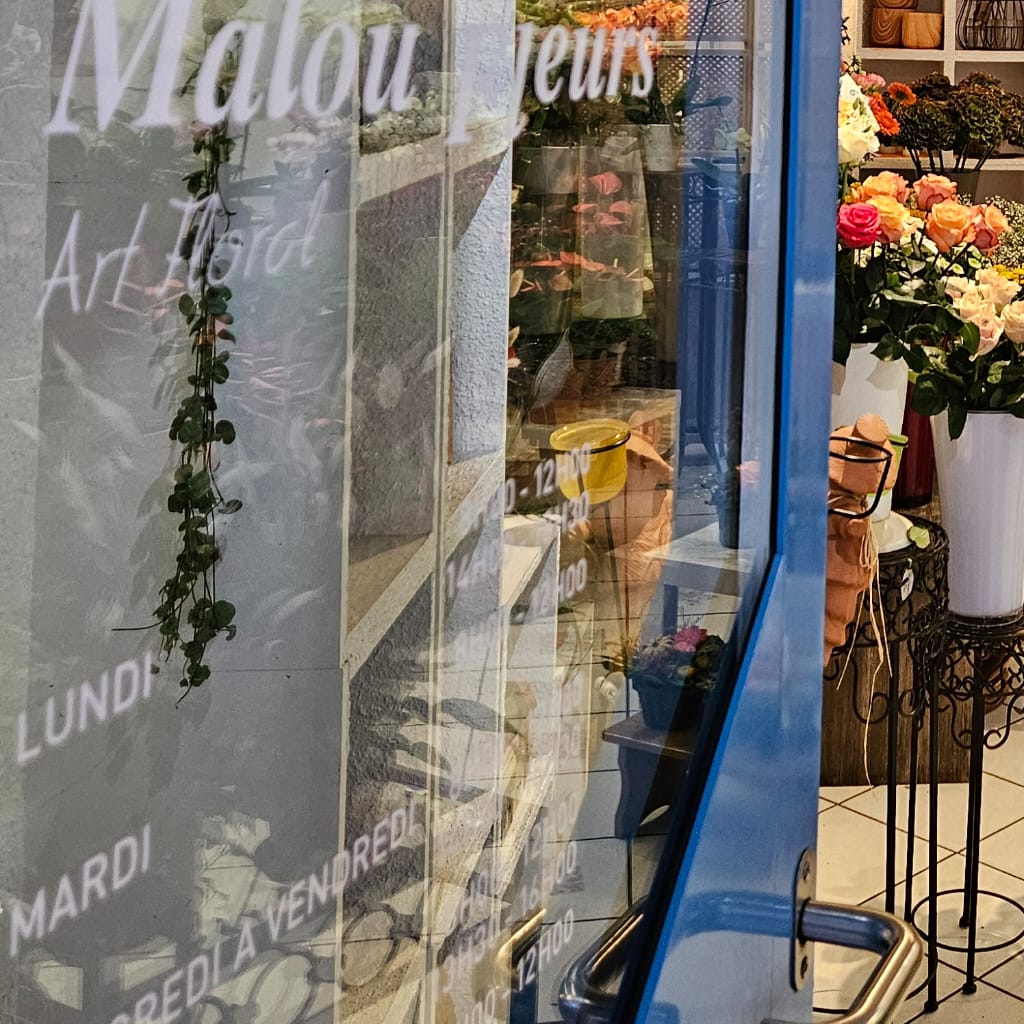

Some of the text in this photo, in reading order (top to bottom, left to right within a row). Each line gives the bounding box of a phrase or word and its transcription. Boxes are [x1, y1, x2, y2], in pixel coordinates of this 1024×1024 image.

[35, 201, 150, 320] Art
[15, 648, 153, 763] LUNDI
[9, 823, 151, 958] MARDI
[265, 798, 419, 942] VENDREDI
